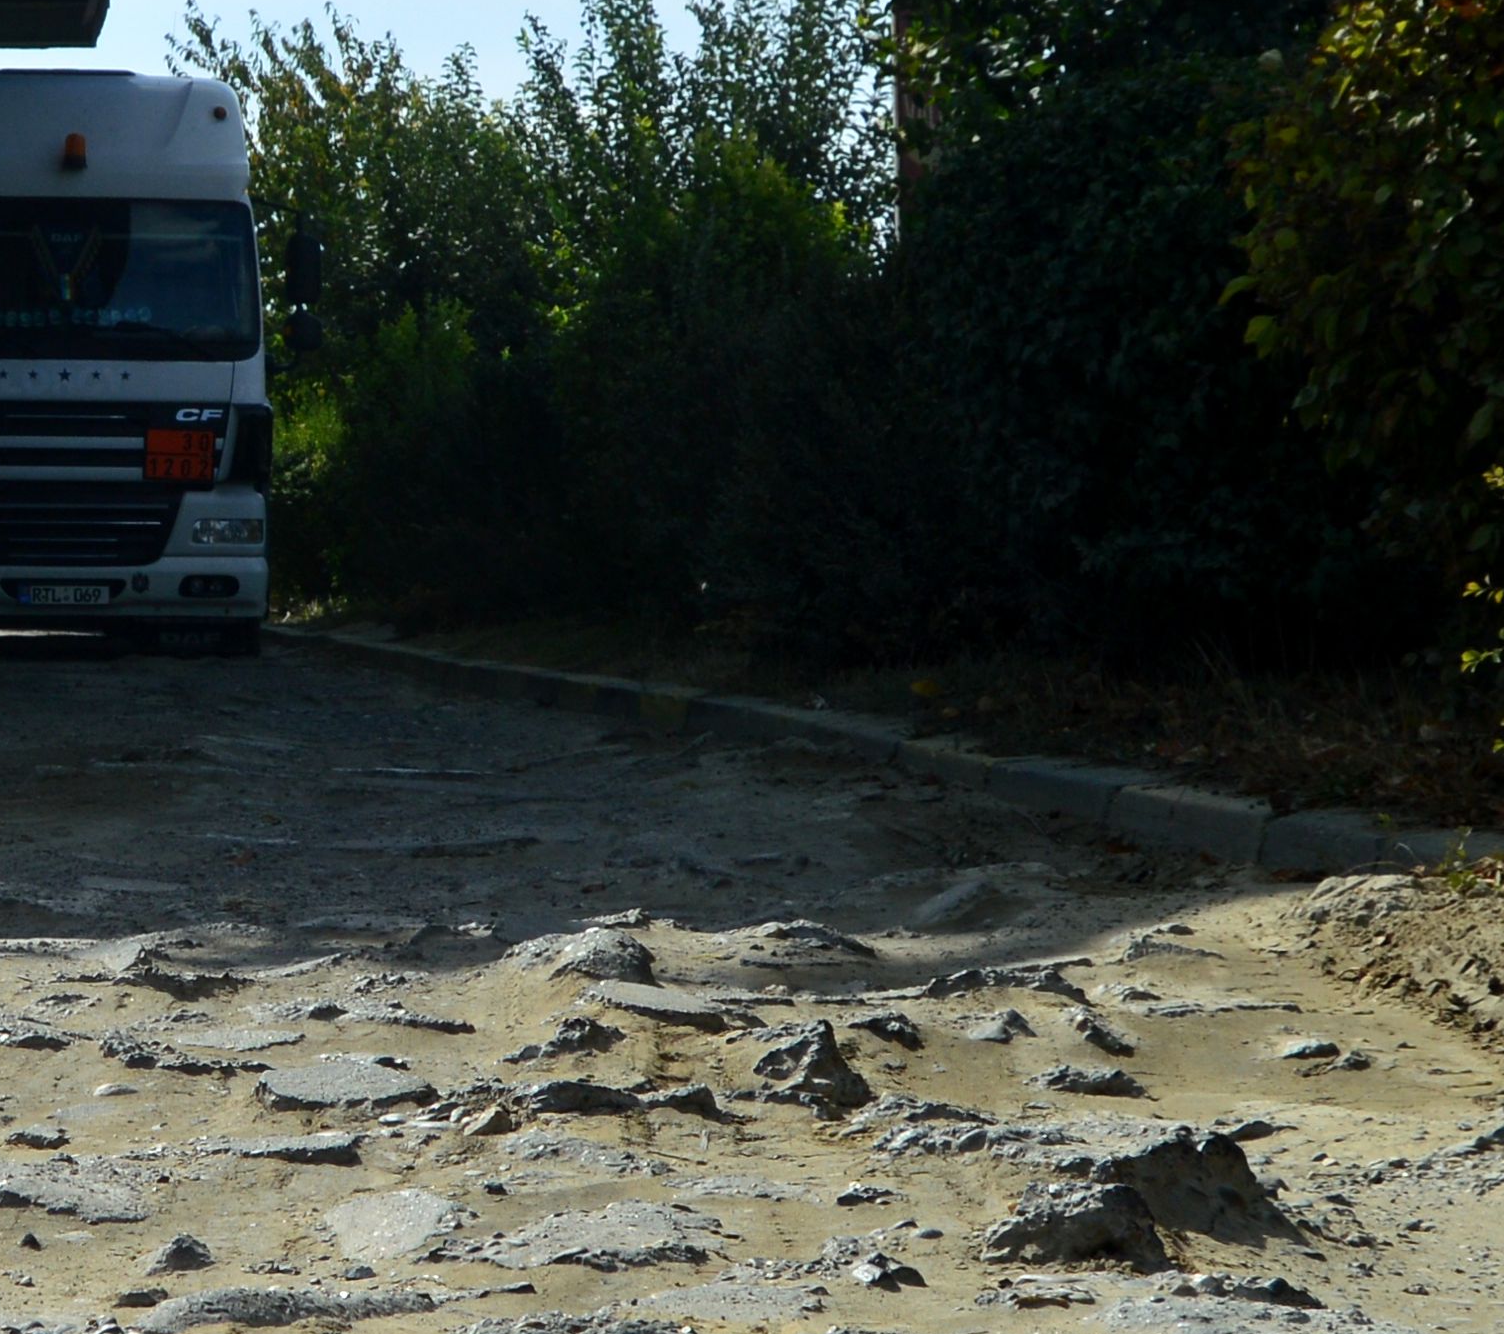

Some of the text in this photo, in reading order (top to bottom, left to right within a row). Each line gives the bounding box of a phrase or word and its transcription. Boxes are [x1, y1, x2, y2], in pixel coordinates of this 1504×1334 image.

[175, 408, 225, 423] CF
[183, 433, 210, 452] 30
[149, 457, 208, 478] 1202
